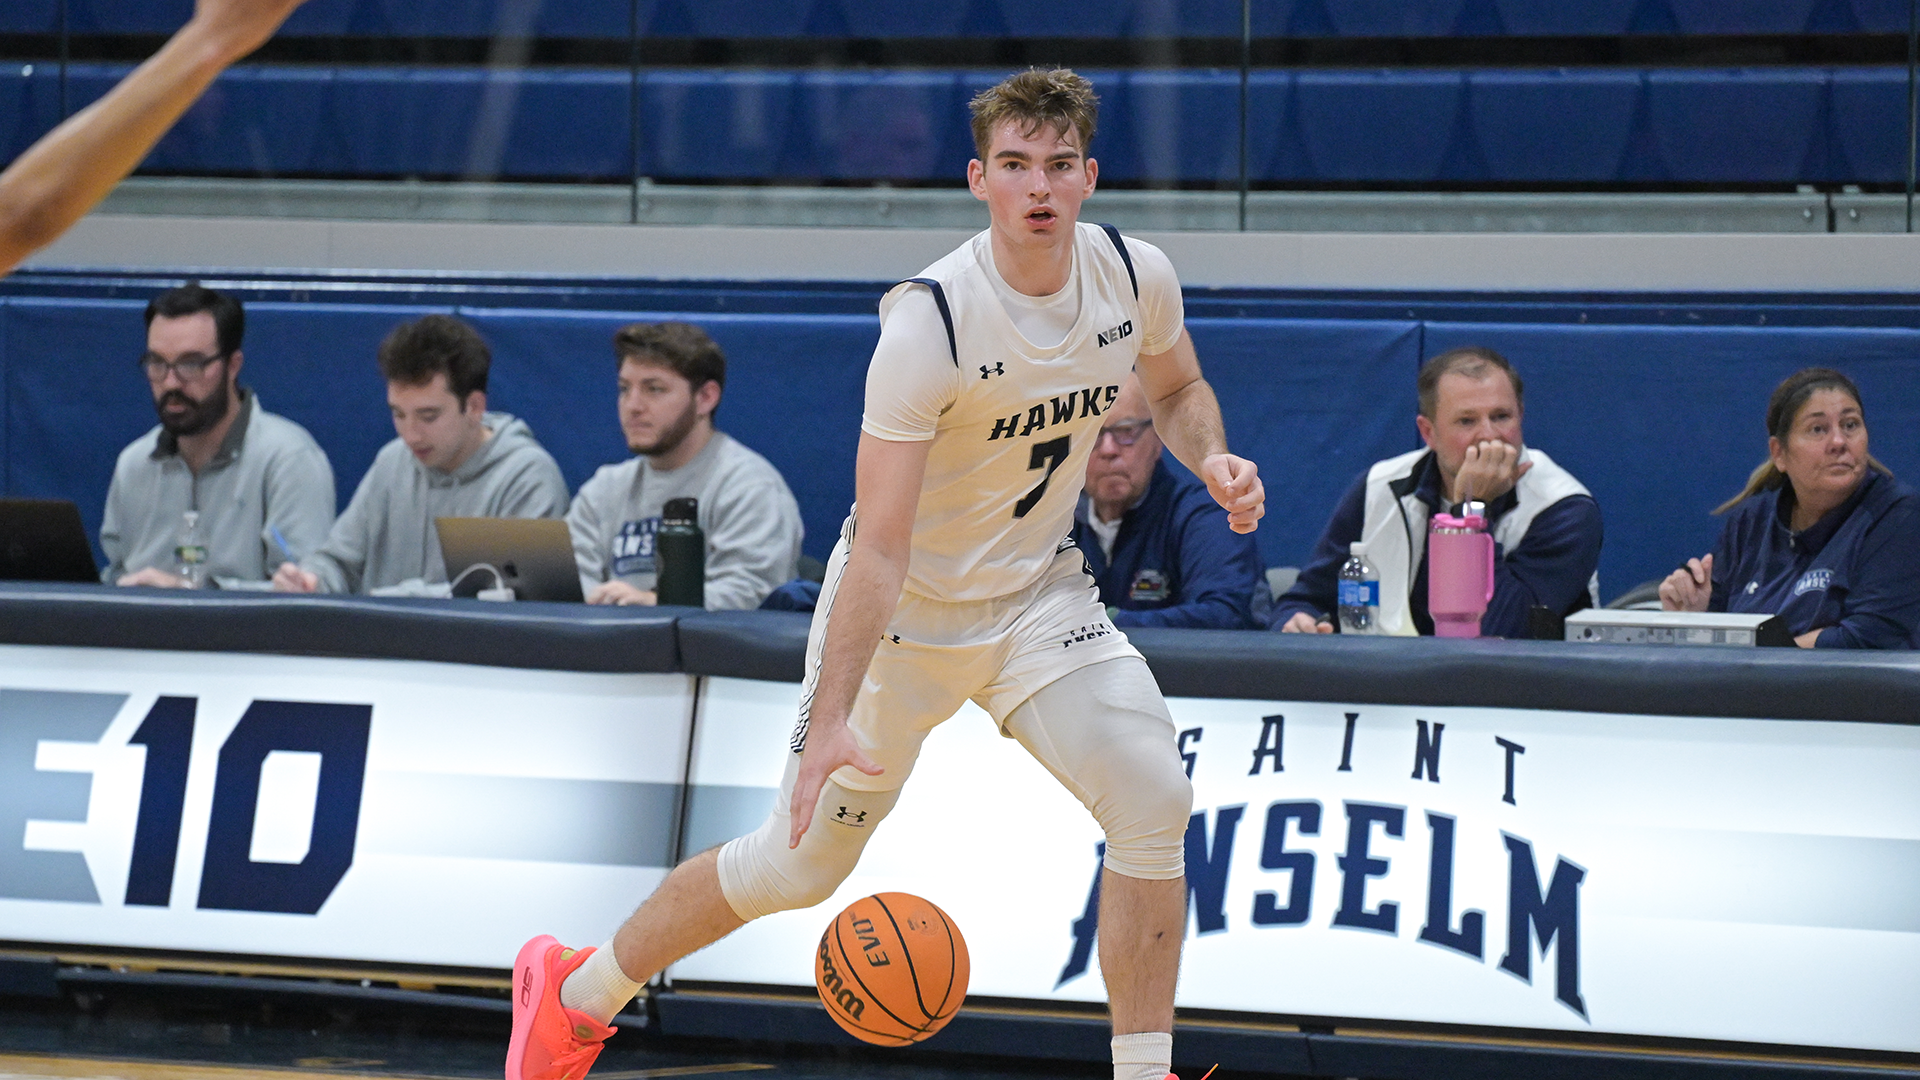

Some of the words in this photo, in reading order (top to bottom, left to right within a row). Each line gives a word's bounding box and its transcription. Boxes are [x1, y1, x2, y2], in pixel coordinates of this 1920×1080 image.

[1097, 319, 1133, 348] NE10
[987, 385, 1119, 441] HAWKS
[1012, 433, 1072, 519] 7
[1177, 712, 1526, 807] SAINT
[0, 688, 374, 916] E10
[852, 918, 891, 967] EVO
